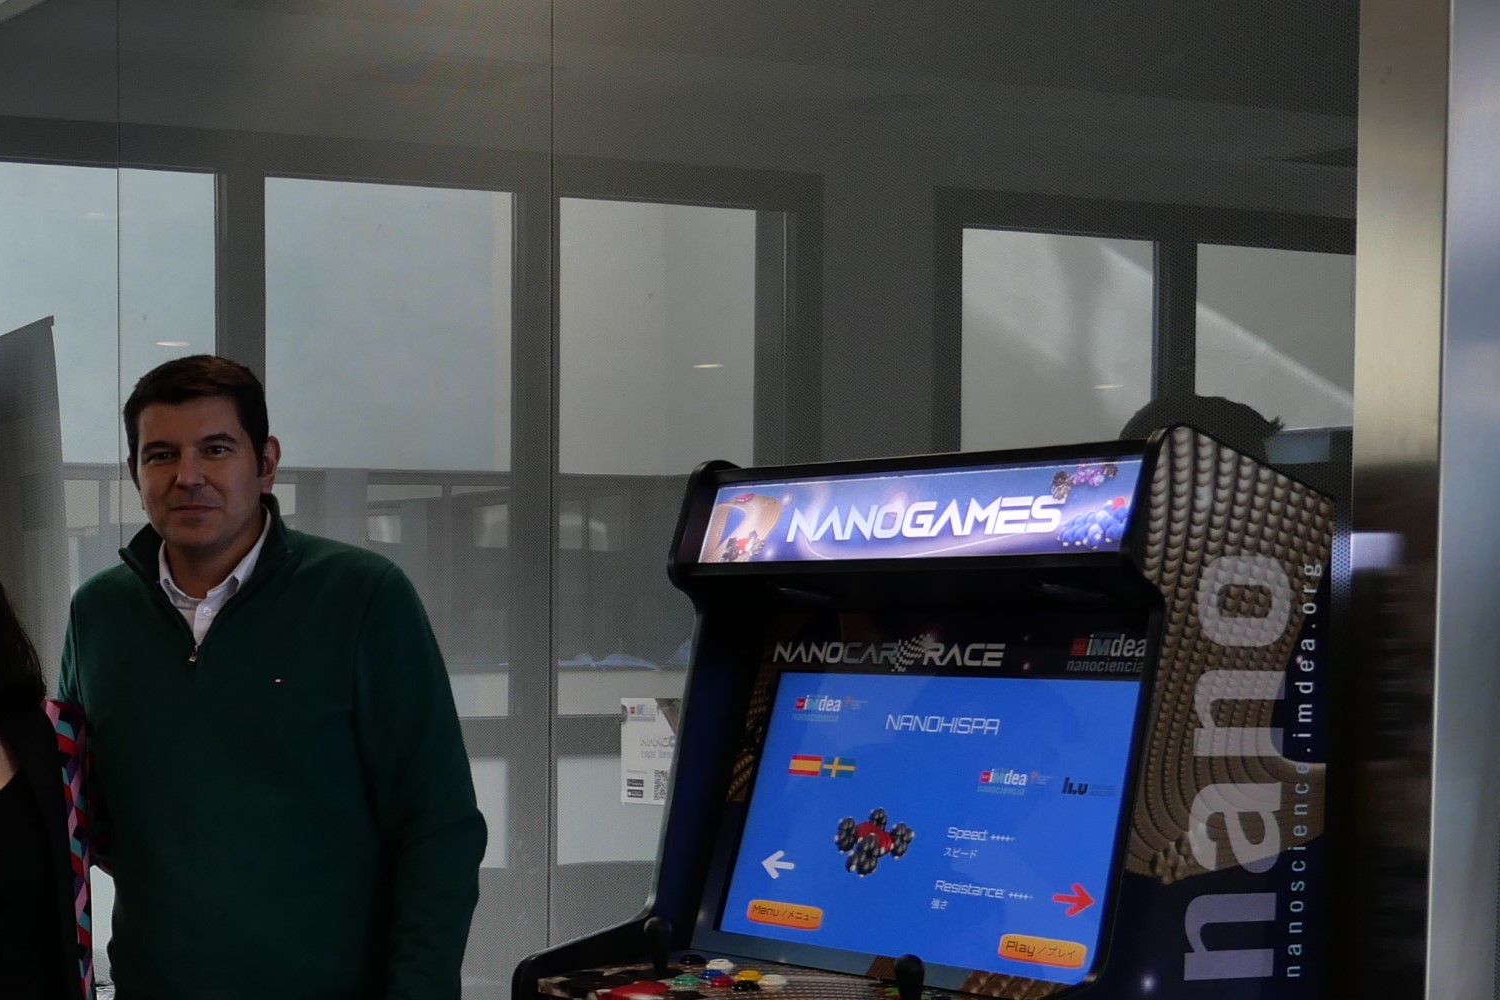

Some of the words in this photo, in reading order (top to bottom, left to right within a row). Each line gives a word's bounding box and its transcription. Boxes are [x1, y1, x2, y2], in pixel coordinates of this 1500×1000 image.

[786, 494, 1066, 543] NANOGAMES
[1183, 555, 1291, 981] nano
[1286, 563, 1322, 978] nanoscience.imdea.org
